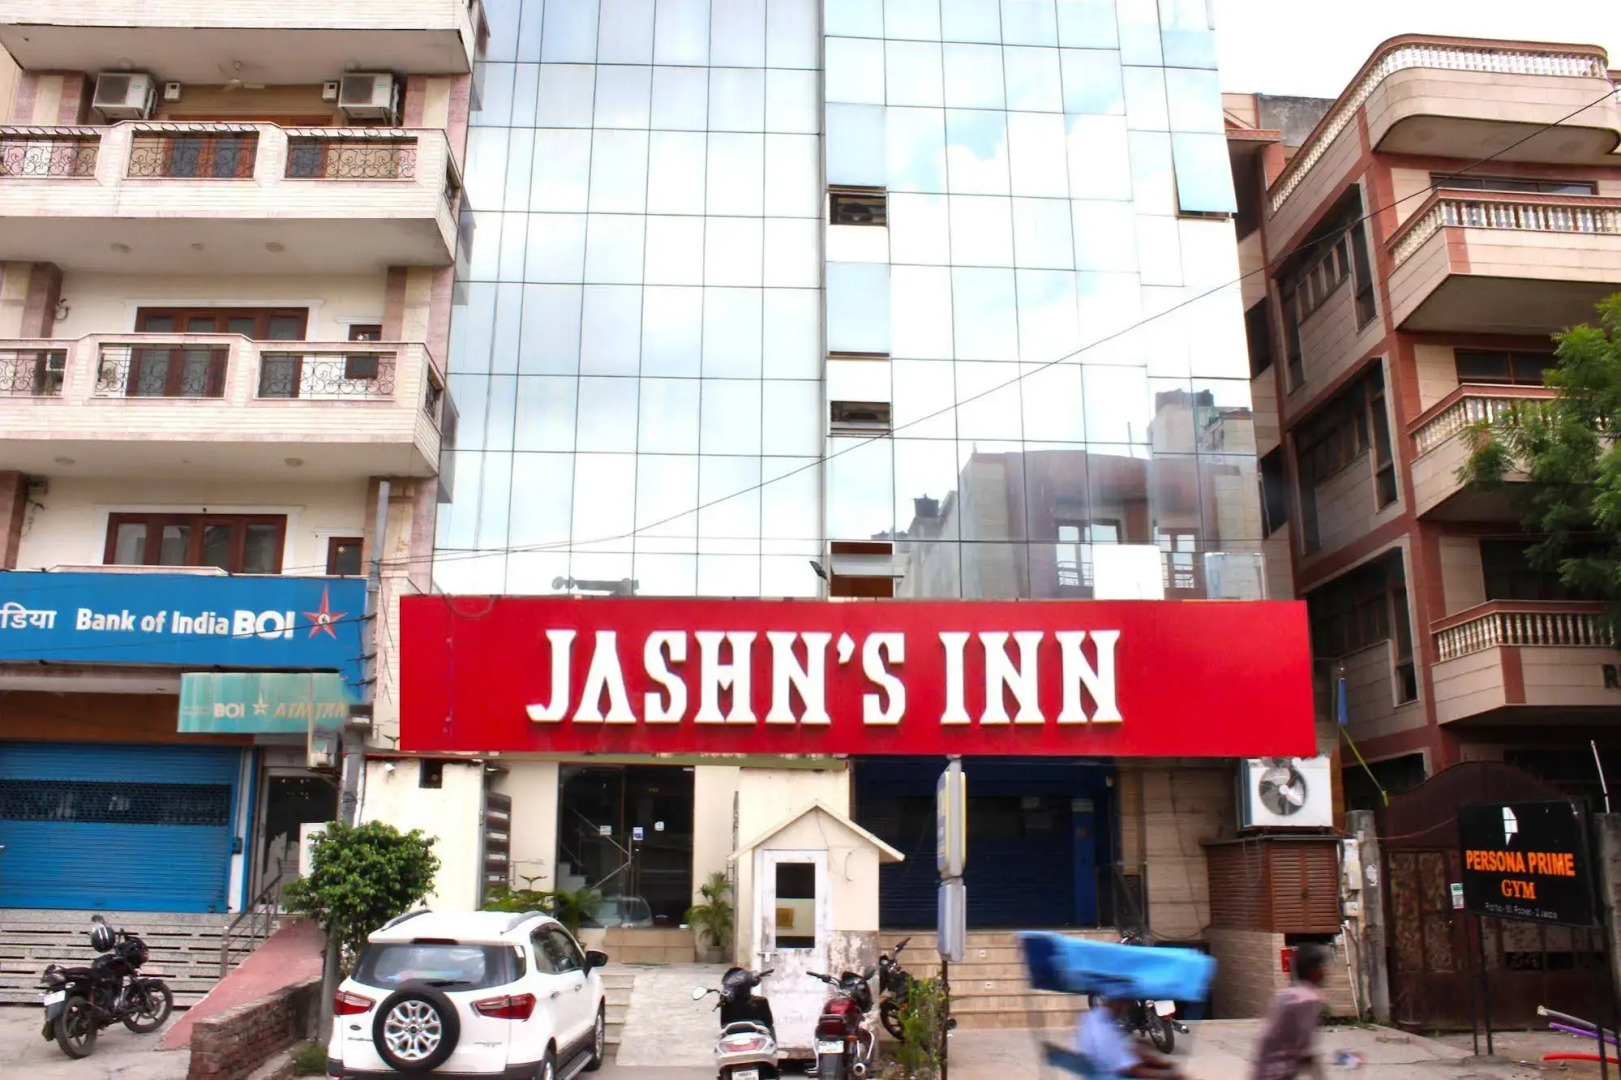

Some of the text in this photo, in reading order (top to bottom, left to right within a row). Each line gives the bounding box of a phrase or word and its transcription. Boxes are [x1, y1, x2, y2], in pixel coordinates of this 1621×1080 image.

[0, 602, 57, 629] डिया
[76, 608, 295, 639] Bank of India BOI
[526, 629, 1123, 724] JASHN'S INN
[213, 703, 246, 718] BOI
[1466, 850, 1576, 876] PERSONA PRIME
[1501, 879, 1536, 899] GYM
